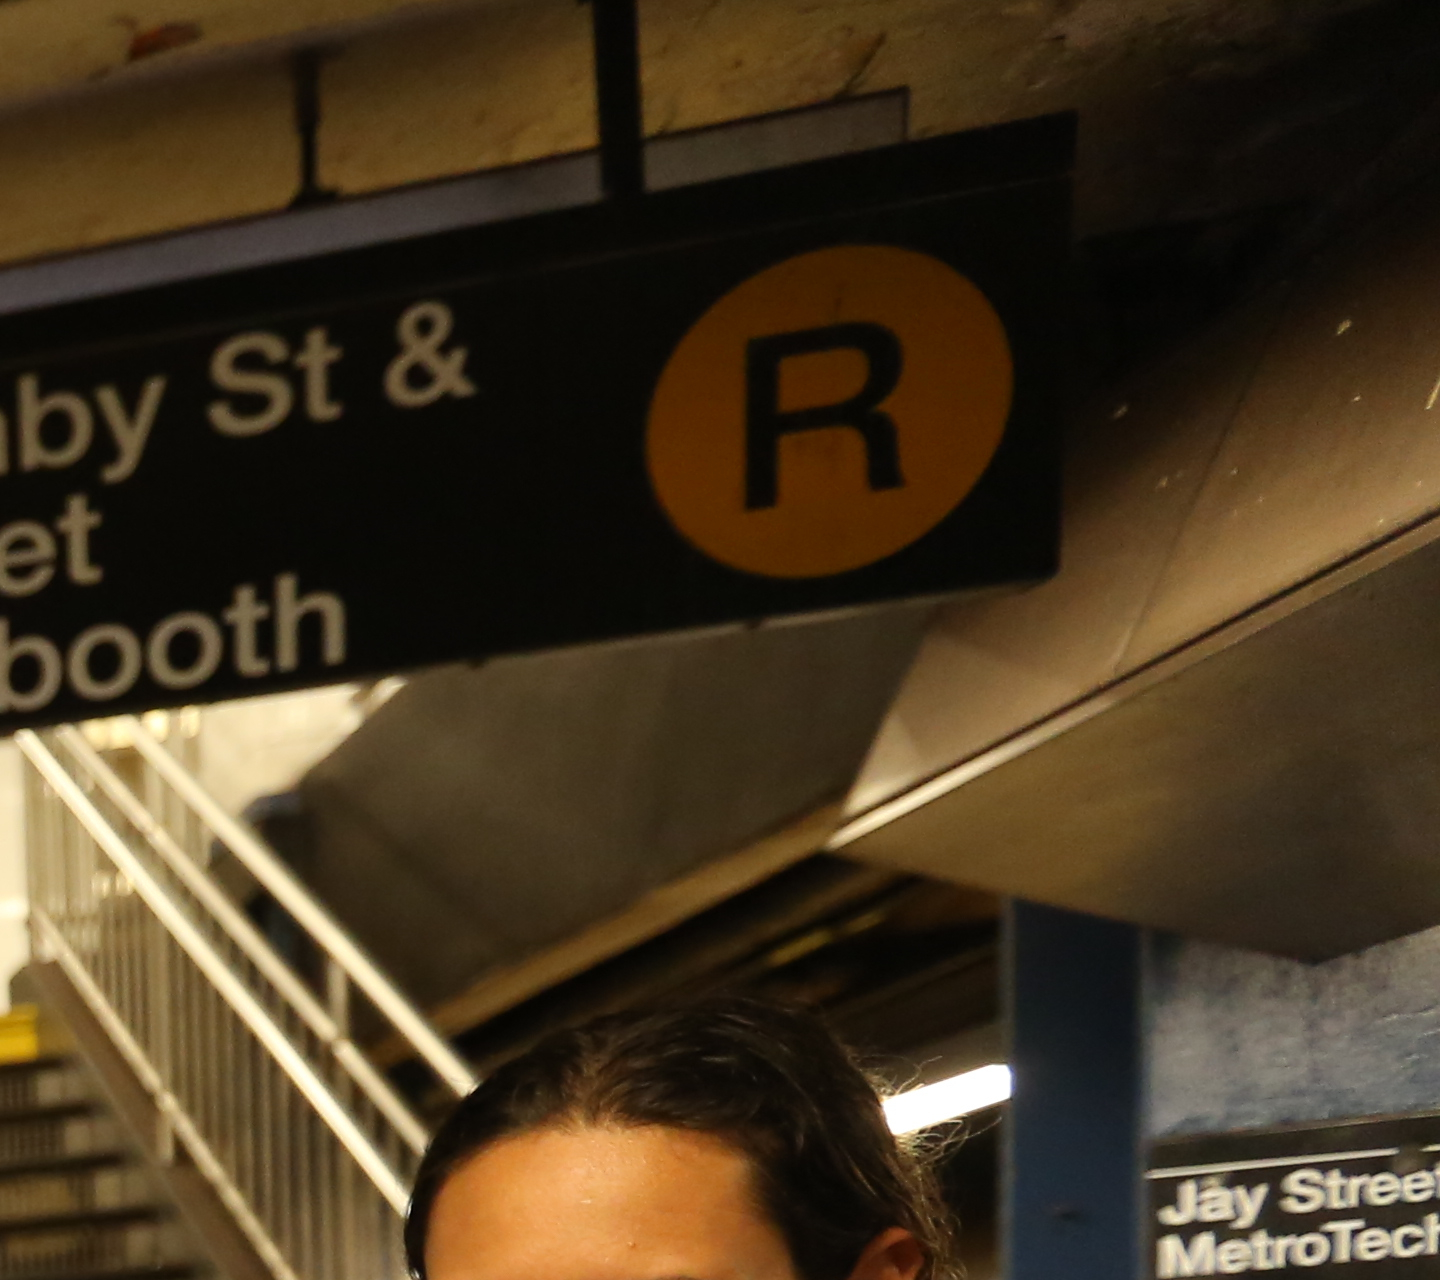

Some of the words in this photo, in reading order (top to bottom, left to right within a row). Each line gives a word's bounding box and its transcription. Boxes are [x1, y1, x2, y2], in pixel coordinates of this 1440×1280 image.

[208, 328, 342, 438] St
[384, 300, 476, 408] &
[744, 320, 906, 512] R
[1157, 1177, 1271, 1230] Jay
